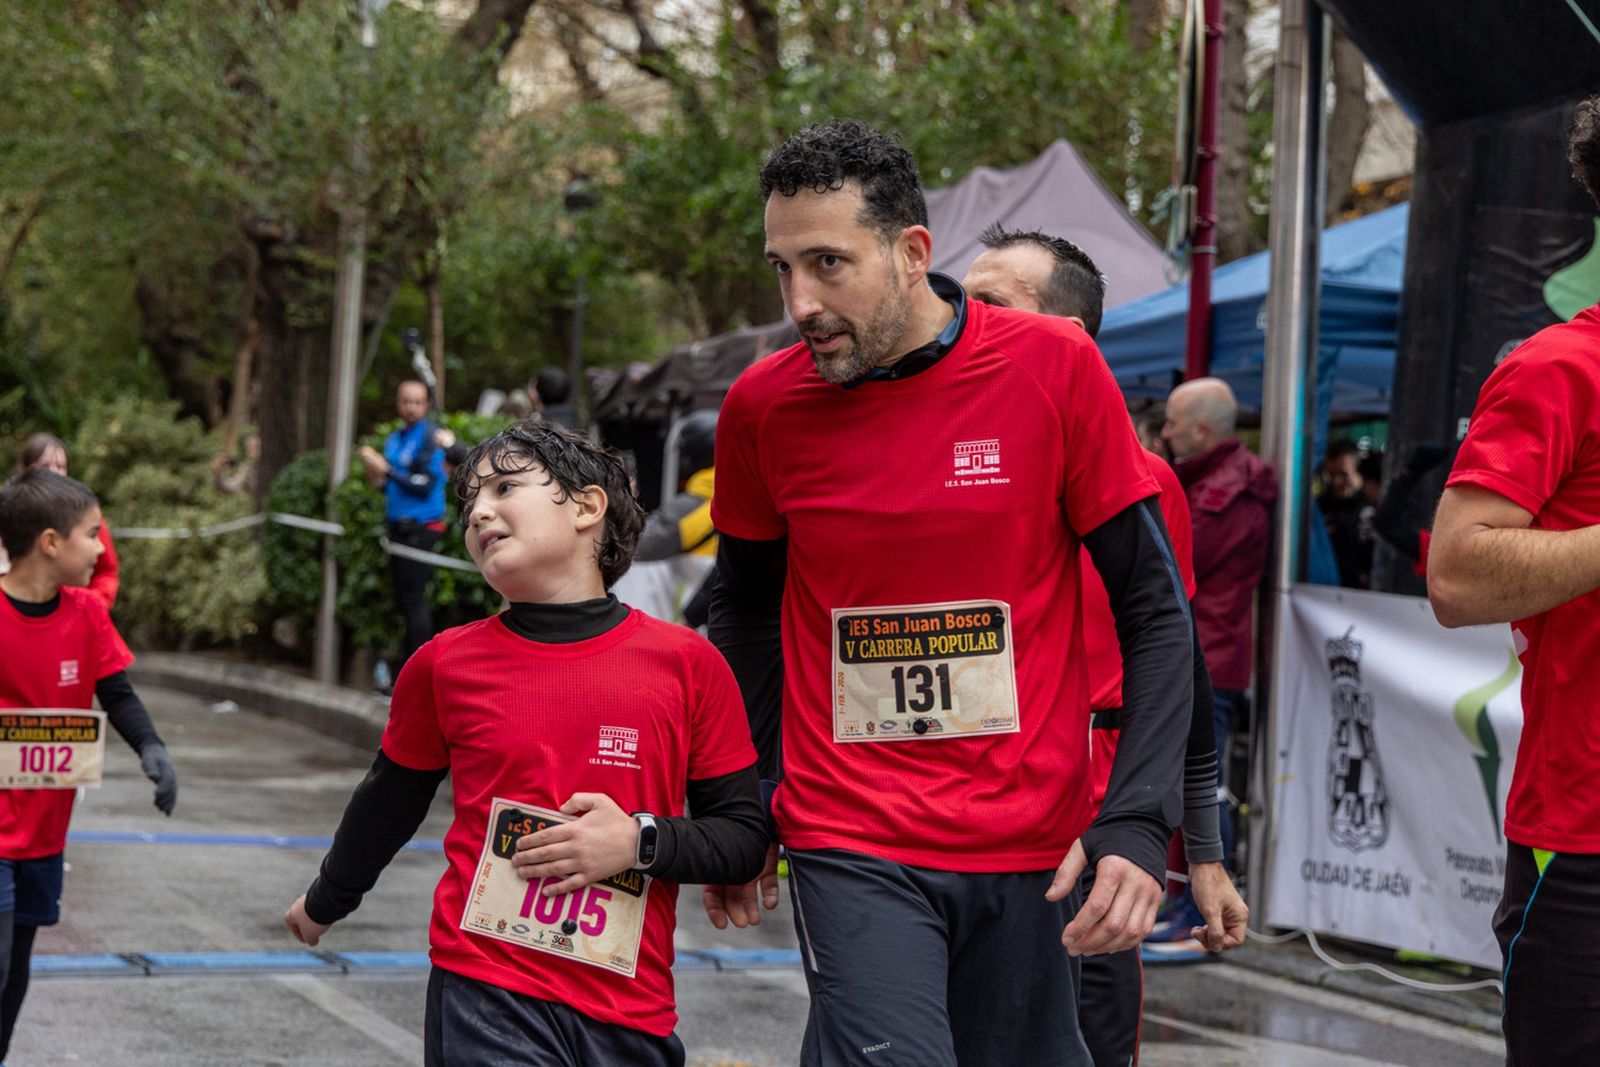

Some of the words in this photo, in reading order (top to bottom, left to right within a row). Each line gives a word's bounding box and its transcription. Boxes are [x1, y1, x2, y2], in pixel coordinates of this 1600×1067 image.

[961, 479, 973, 487] San
[974, 478, 989, 486] Juan
[990, 477, 1011, 485] Bosco
[873, 618, 899, 636] San
[904, 616, 940, 634] Juan
[945, 612, 991, 630] Bosco
[845, 640, 855, 659] V
[859, 638, 924, 659] CARRERA
[928, 632, 998, 656] POPULAR
[891, 663, 952, 714] 131
[20, 745, 73, 773] 1012
[501, 834, 512, 853] V
[1352, 866, 1373, 892] DE
[1375, 867, 1412, 896] JAÉN
[519, 875, 613, 937] 1015
